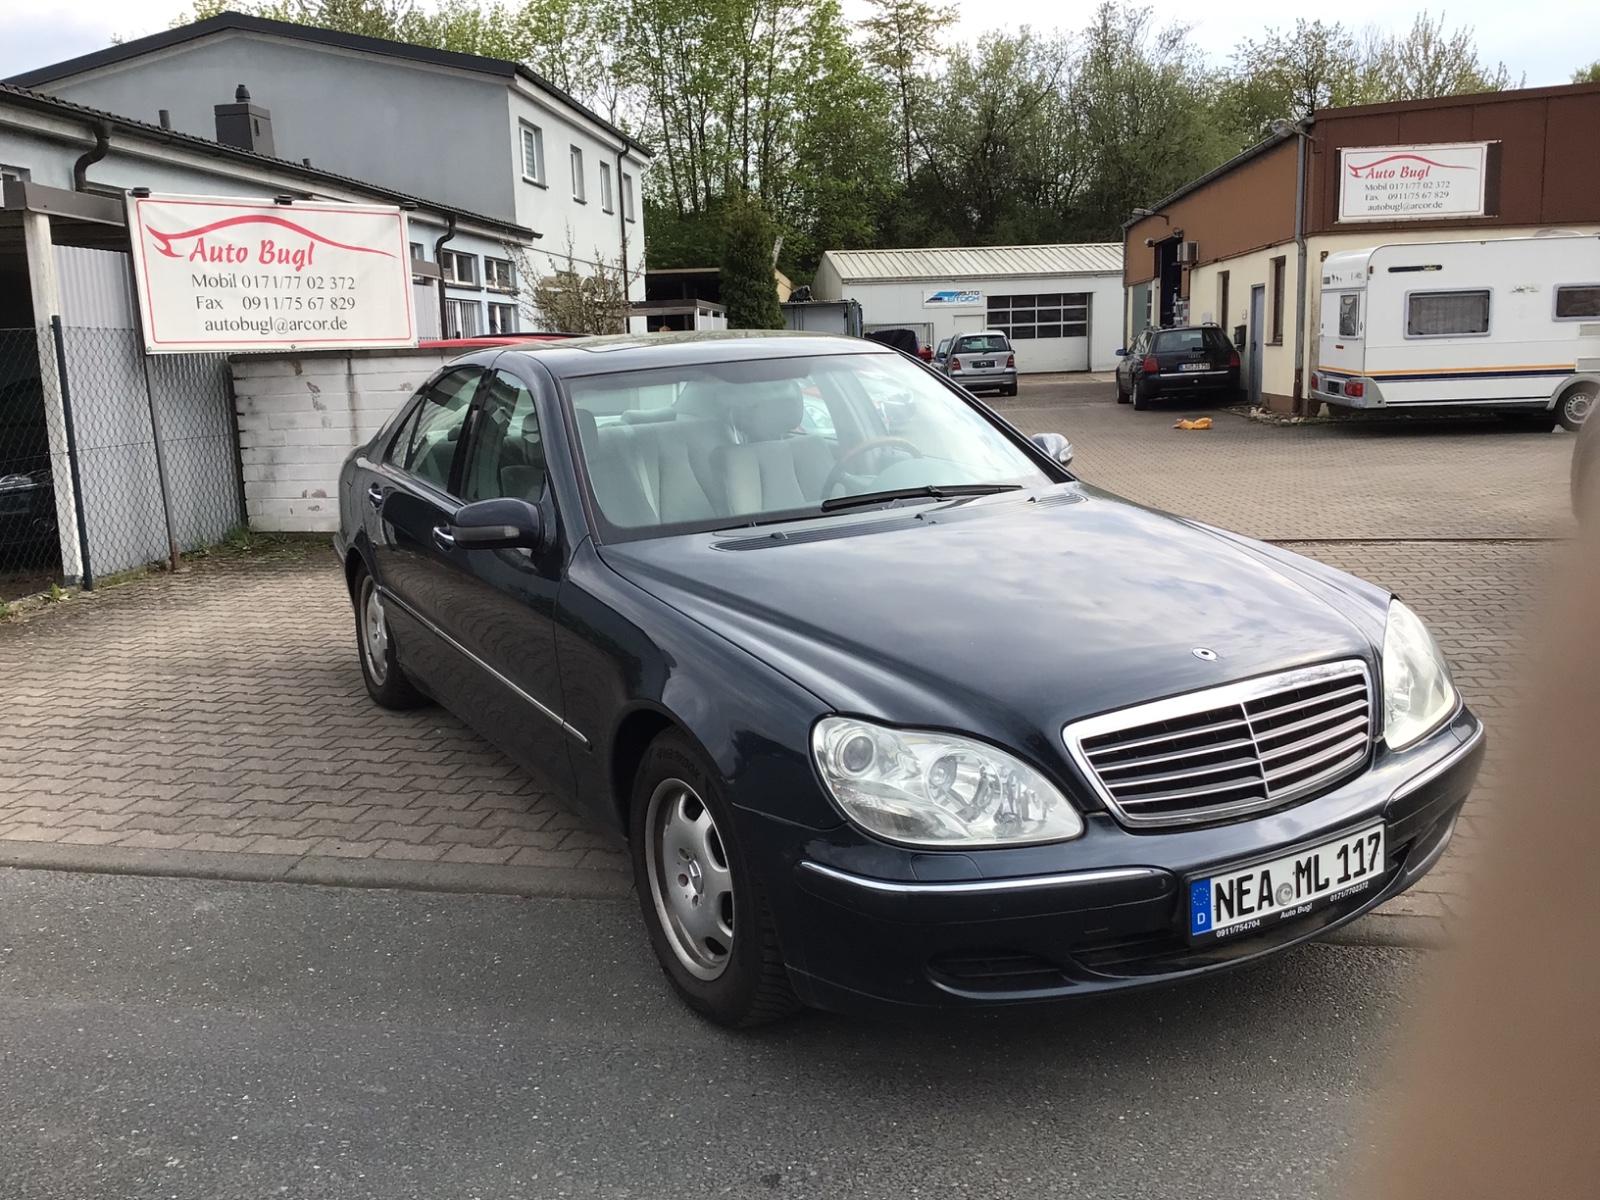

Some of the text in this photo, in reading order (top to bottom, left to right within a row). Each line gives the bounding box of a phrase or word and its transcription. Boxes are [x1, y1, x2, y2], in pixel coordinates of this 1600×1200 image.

[1365, 165, 1430, 180] Auto Bugl
[1365, 183, 1387, 191] Mobil
[1389, 182, 1421, 191] 0171/77
[1435, 181, 1450, 189] 372
[1388, 192, 1420, 200] 0911/75
[1434, 191, 1449, 199] 829
[1367, 201, 1443, 212] autobugl@arcor.de
[189, 237, 315, 272] Auto Bugl
[191, 272, 356, 290] Mobil 0171/77 02 372
[196, 296, 356, 310] Fax 0911/75 67 829
[204, 316, 348, 335] autobugl@arcor.de
[1213, 831, 1381, 922] NEA ML 117
[1197, 912, 1206, 925] D
[1216, 919, 1261, 938] 0911/754704
[1280, 909, 1296, 919] Auto
[1297, 903, 1313, 915] Bugl
